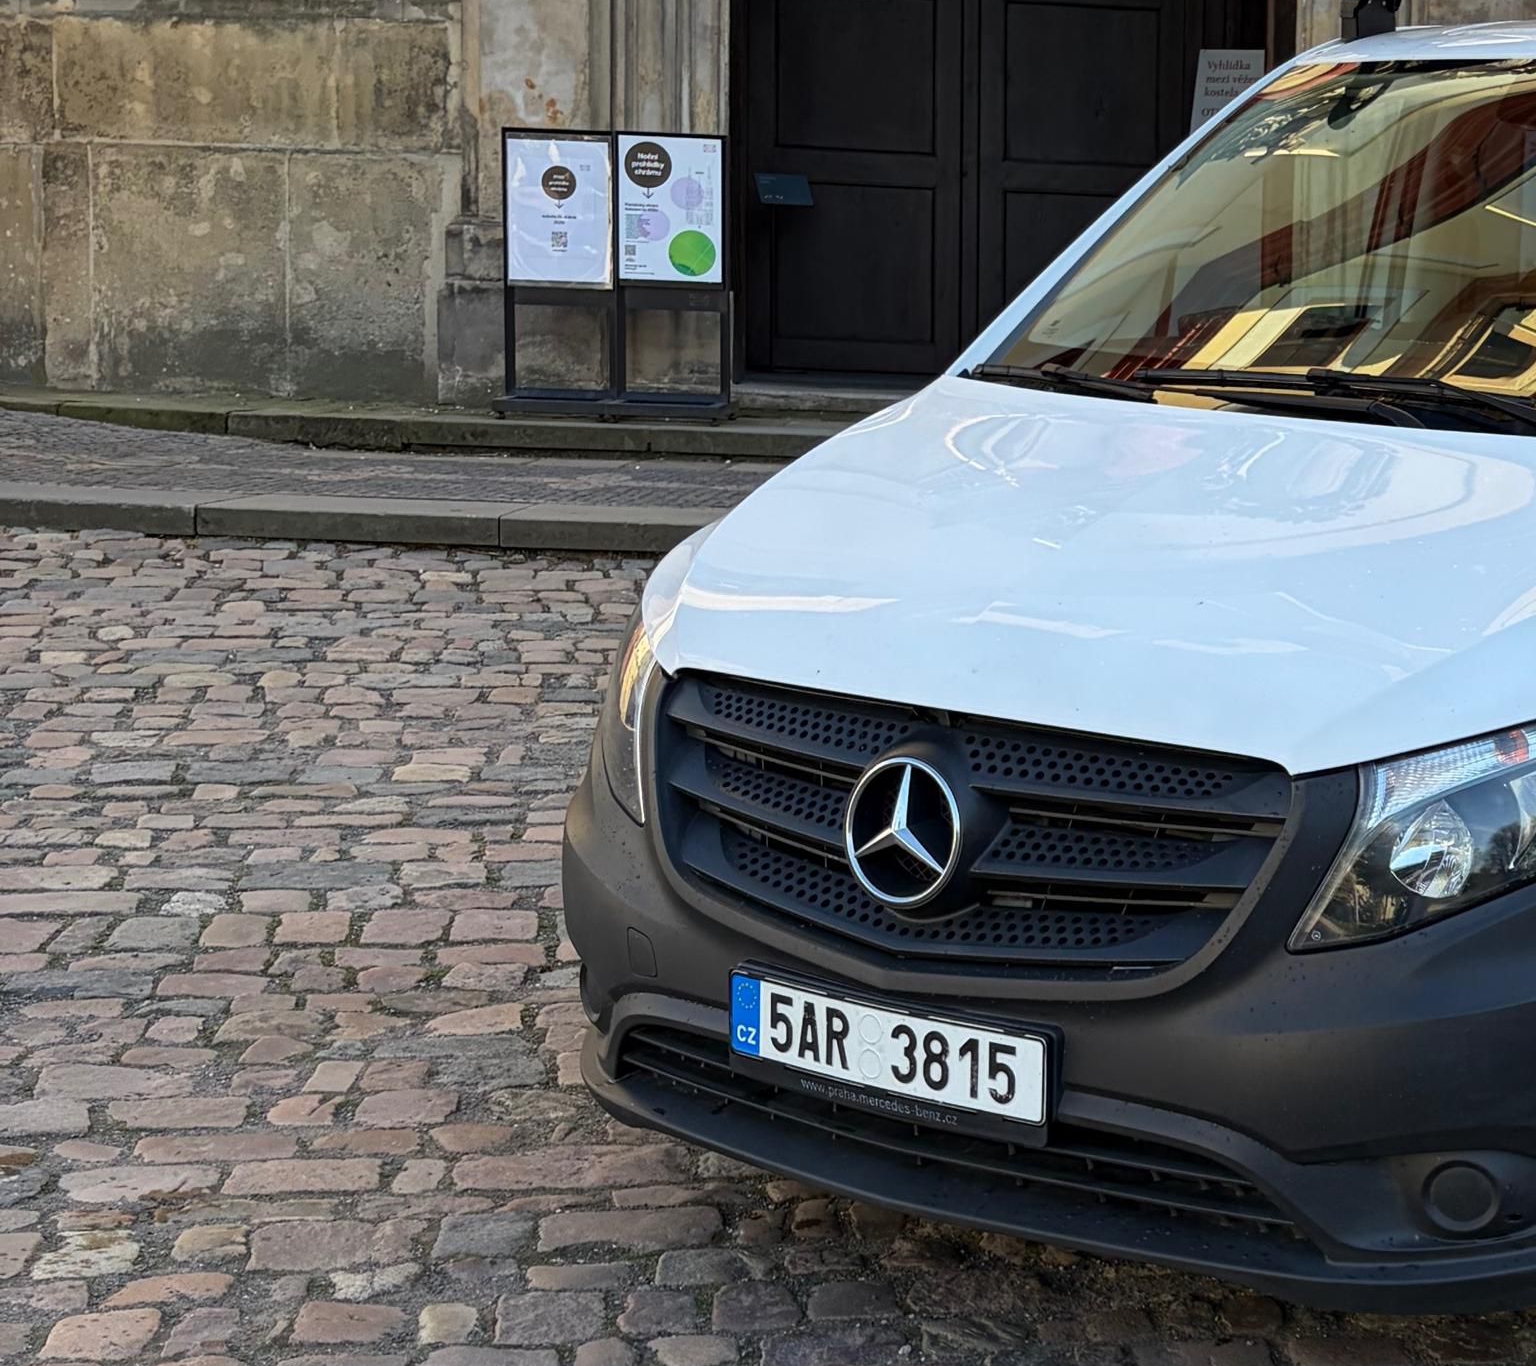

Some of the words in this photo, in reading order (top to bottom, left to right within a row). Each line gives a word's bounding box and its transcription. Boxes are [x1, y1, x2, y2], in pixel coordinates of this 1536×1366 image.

[1207, 59, 1251, 73] Vyhlídka
[1206, 75, 1229, 84] mezi
[736, 1023, 757, 1045] CZ
[769, 991, 850, 1071] 5AR
[890, 1023, 1017, 1105] 3815
[800, 1078, 958, 1126] www.praha.mercedes-benz.cz
